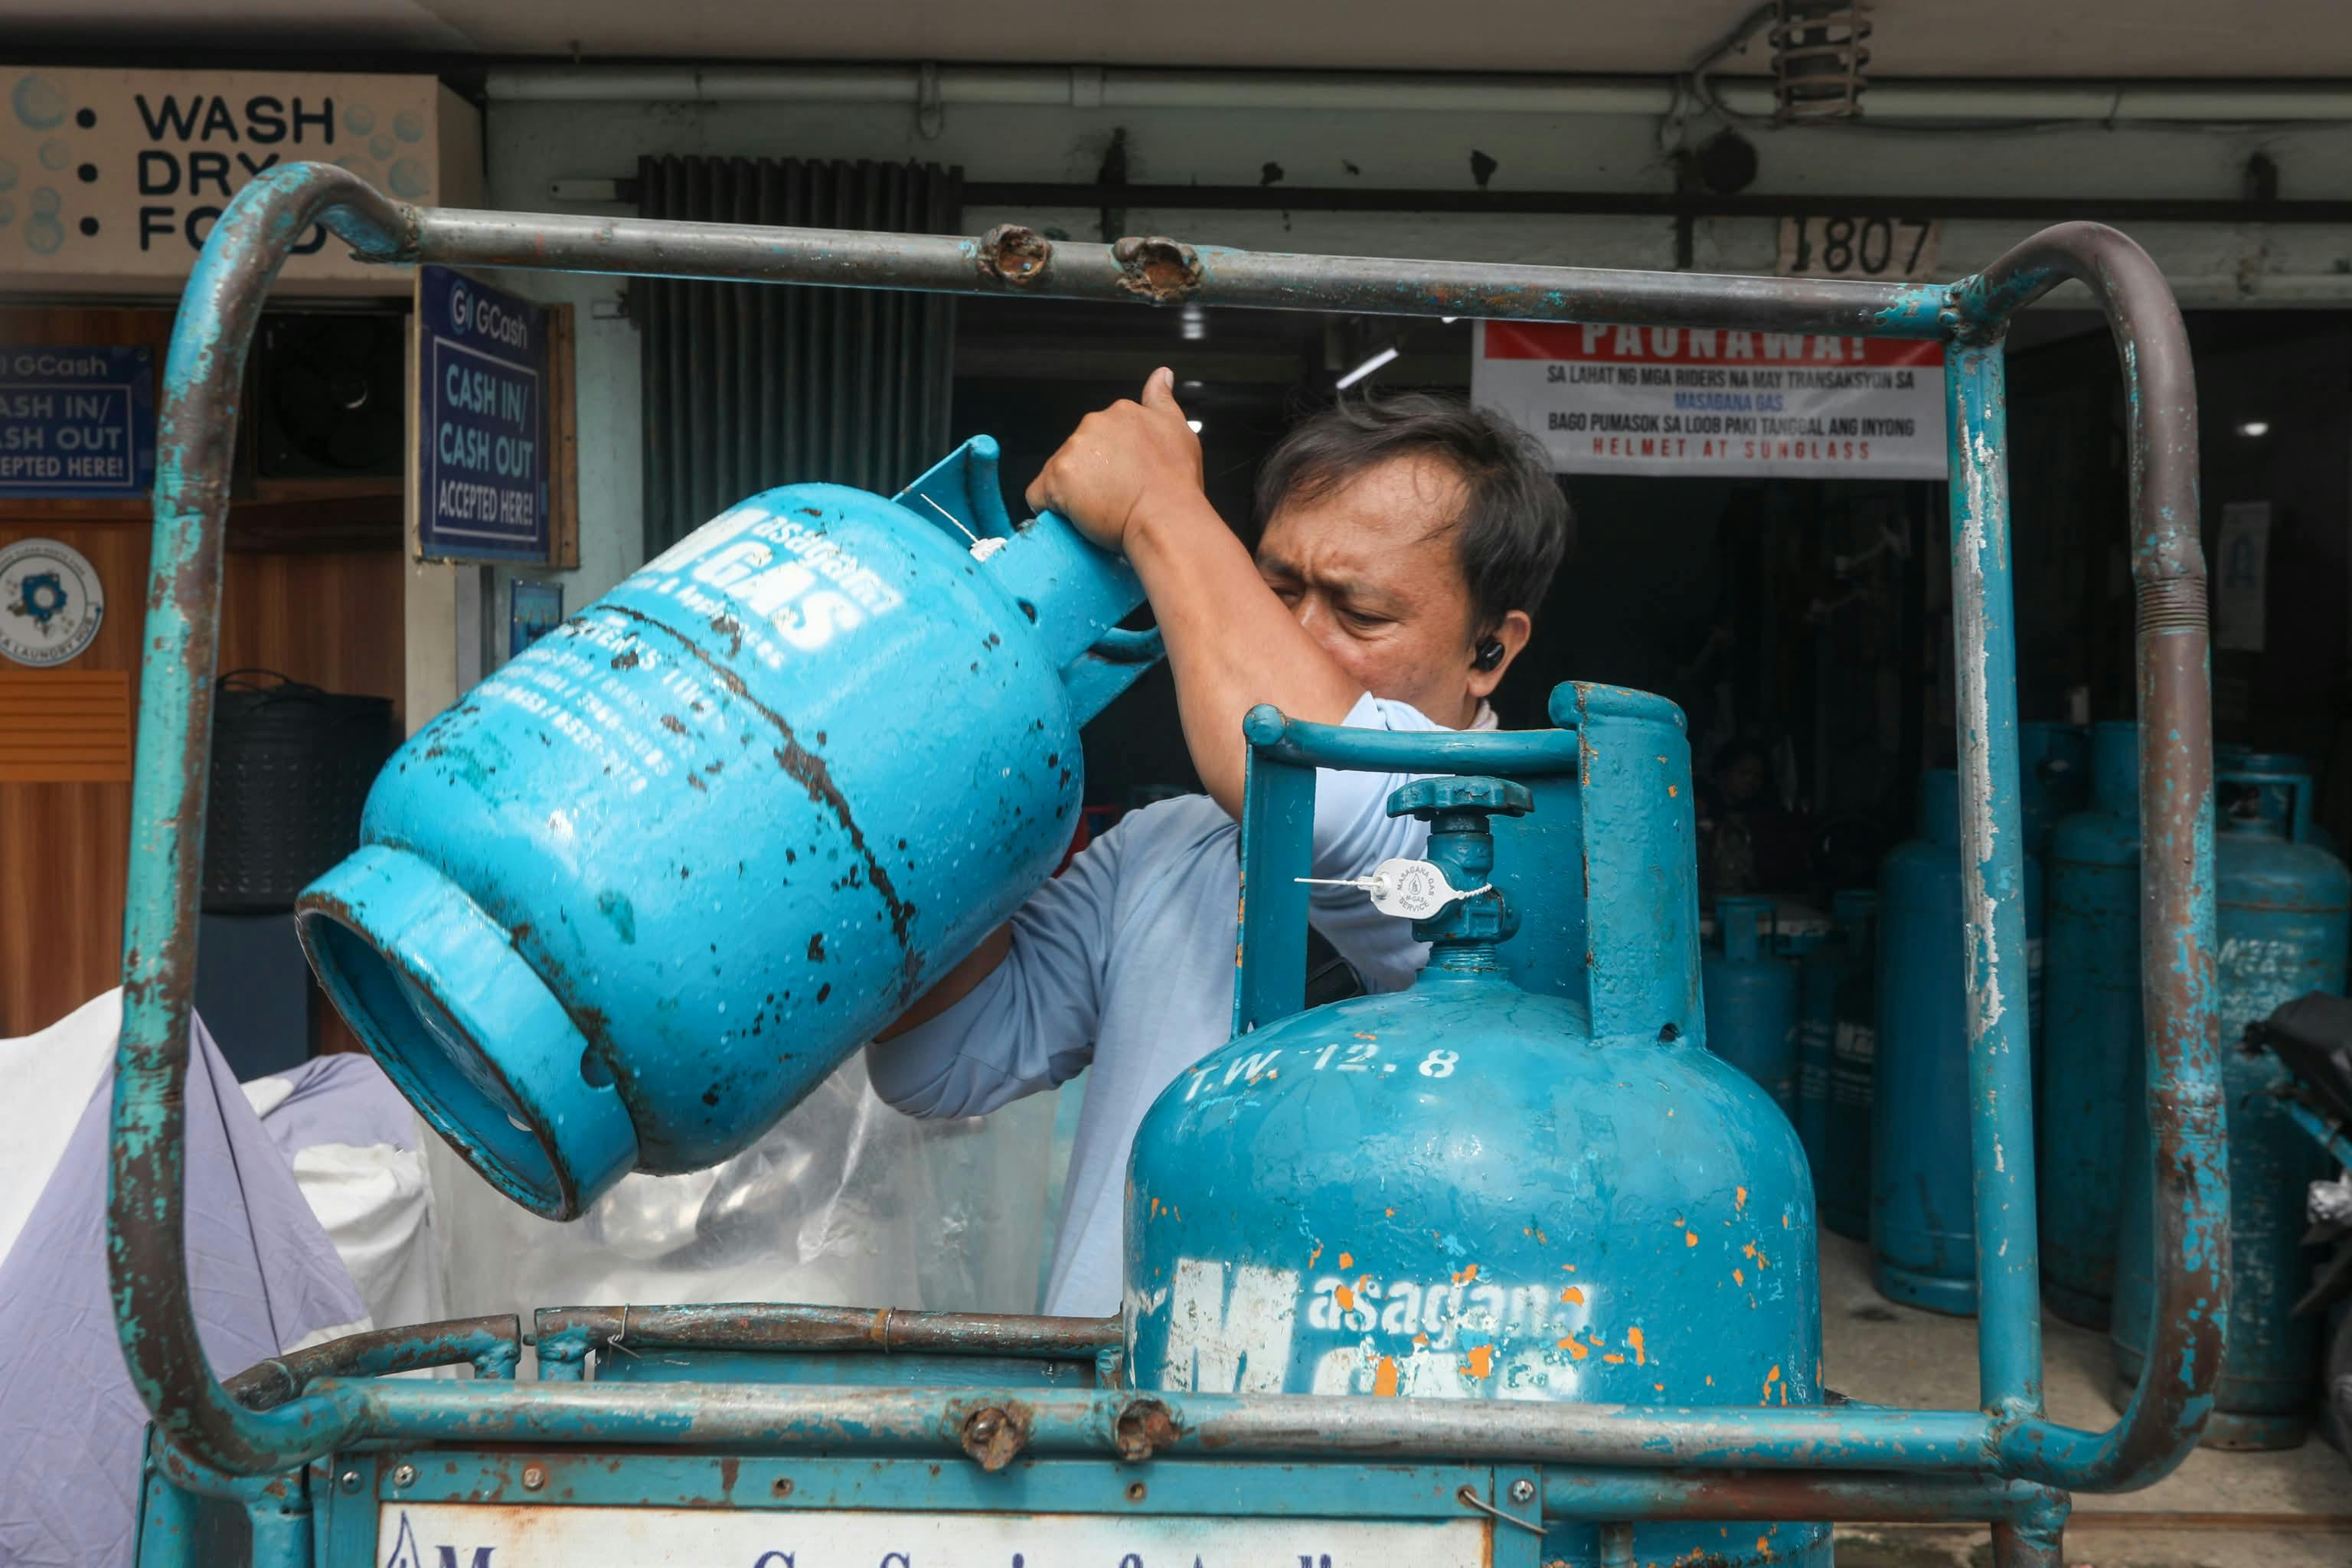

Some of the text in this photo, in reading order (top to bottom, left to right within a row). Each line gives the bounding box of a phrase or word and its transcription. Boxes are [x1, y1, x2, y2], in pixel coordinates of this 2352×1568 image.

[135, 93, 335, 145] WASH
[139, 206, 328, 254] FO
[1791, 217, 1930, 276] 1807
[476, 299, 528, 349] GCash
[15, 354, 108, 377] GCash
[1547, 365, 1915, 390] SA LAHAT NG MGA RIDERS NA MAY TRANSAKSYON SA
[446, 363, 496, 416] CASH
[1674, 391, 1783, 412] MASAGANA GAS
[0, 394, 54, 418] ASH
[1548, 412, 1586, 432] BAGO
[1590, 413, 1660, 433] PUMASOK
[1663, 415, 1681, 433] SA
[1685, 415, 1722, 435] LOOB
[1725, 416, 1757, 435] PAKI
[1828, 418, 1858, 436] ANG
[1862, 417, 1915, 436] INYONG
[56, 426, 122, 451] OUT
[439, 421, 534, 479] CASH OUT
[1592, 437, 1870, 460] HELMET AT SUNGLASS
[0, 456, 123, 478] EPTED HERE!
[439, 479, 534, 527] ACCEPTED HERE!
[1397, 866, 1430, 891] MASAGANA
[1399, 897, 1430, 913] SERVICE
